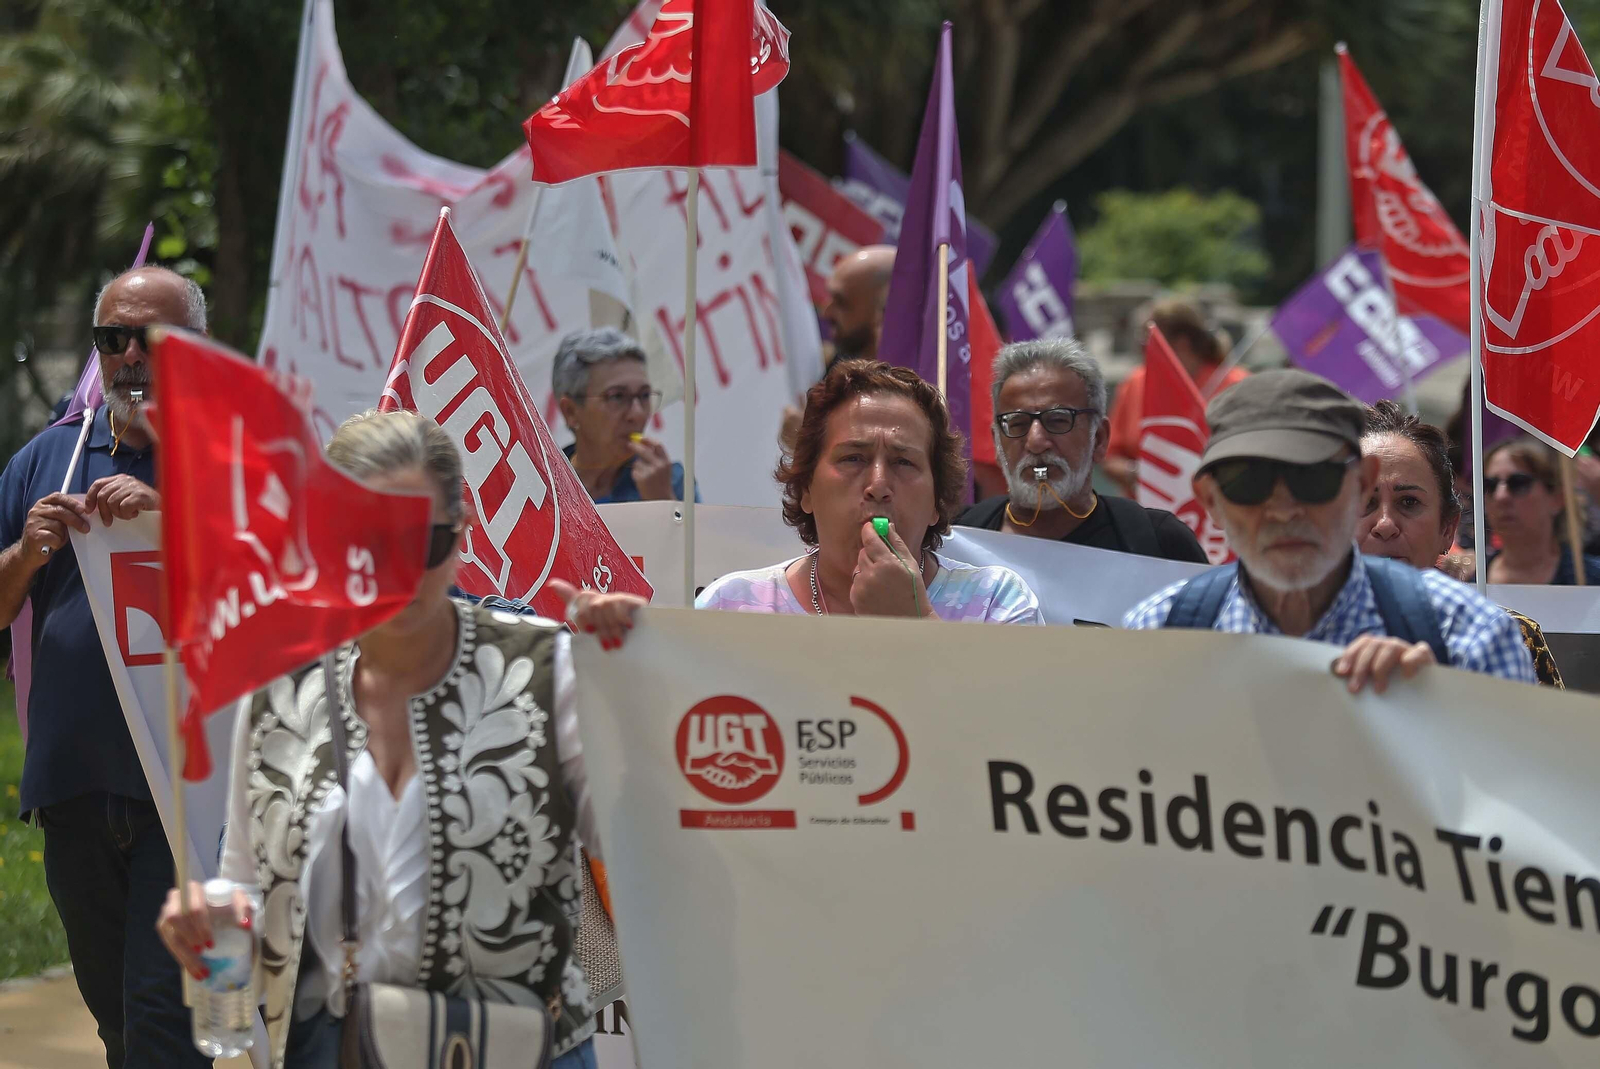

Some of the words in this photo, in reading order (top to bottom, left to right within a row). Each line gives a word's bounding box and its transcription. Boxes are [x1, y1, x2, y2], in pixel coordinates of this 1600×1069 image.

[410, 320, 548, 556] UGT
[687, 713, 769, 757] UGT
[798, 757, 857, 769] Servicios
[987, 760, 1426, 893] Residencia
